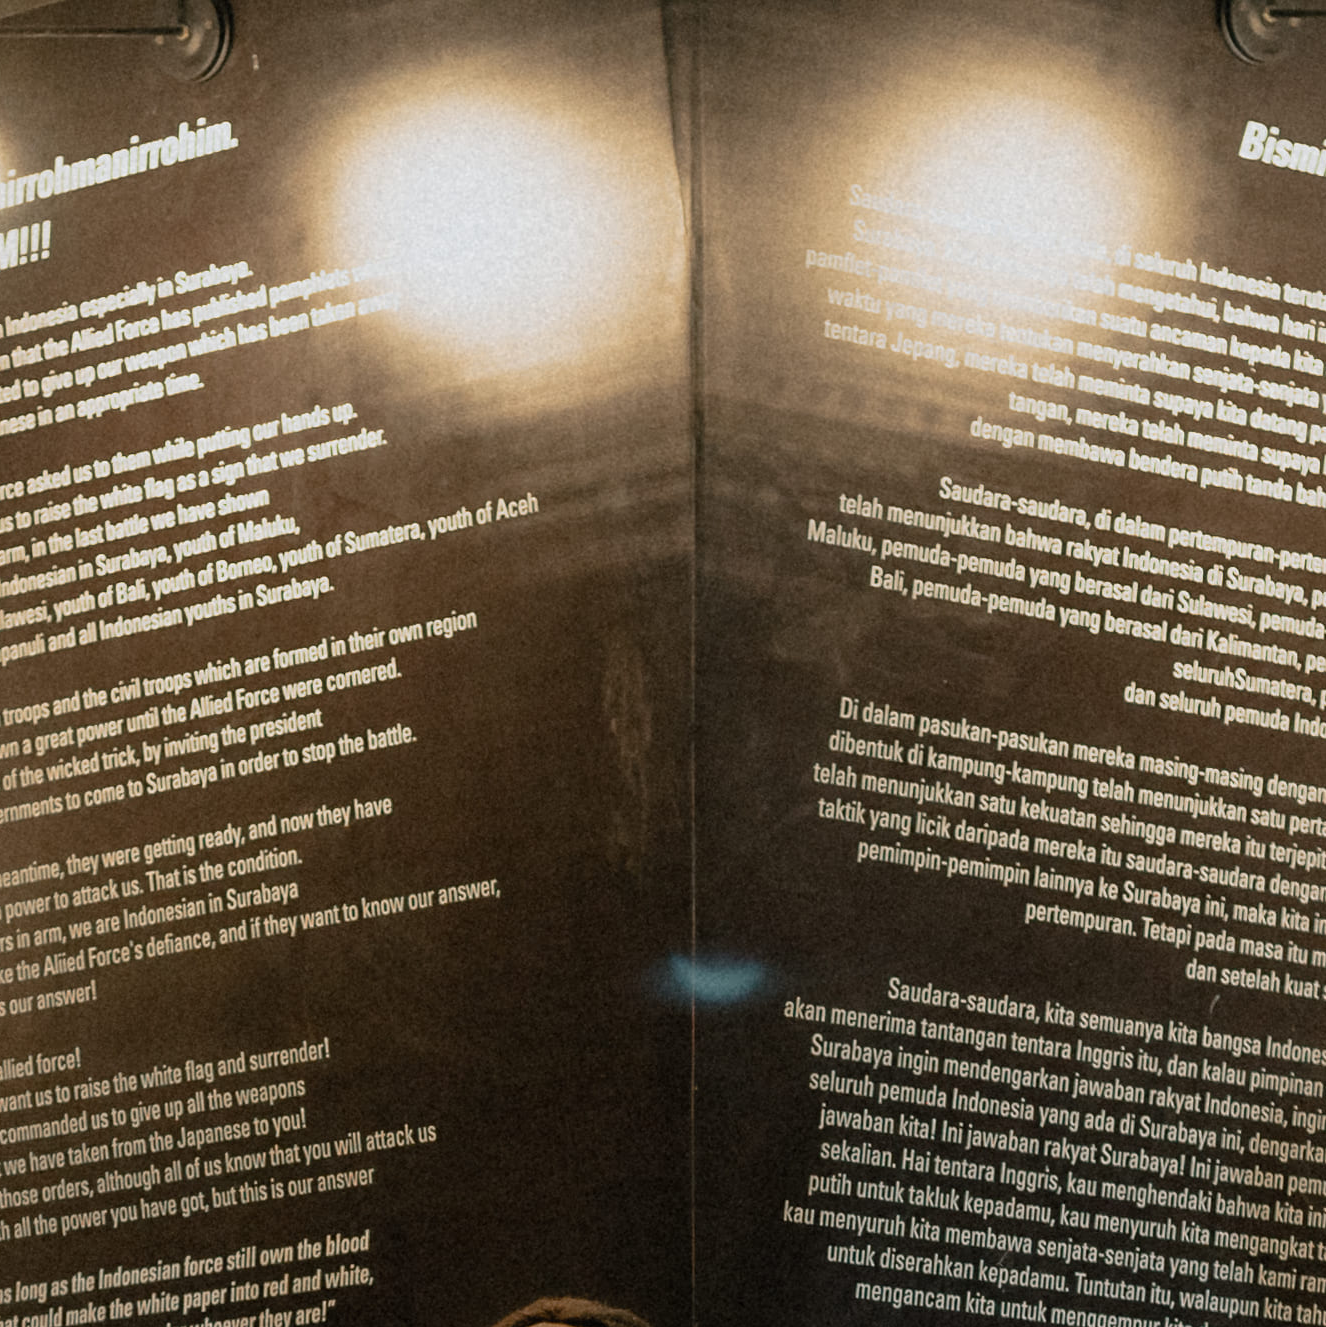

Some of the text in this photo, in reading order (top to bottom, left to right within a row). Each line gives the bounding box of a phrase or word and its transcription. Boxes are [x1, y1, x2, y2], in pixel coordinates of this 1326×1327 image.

[9, 995, 34, 1015] our
[36, 979, 97, 1011] answer!
[1185, 957, 1217, 983] dan
[1220, 968, 1281, 993] setelah
[1284, 972, 1321, 1000] kuat
[35, 1046, 81, 1075] force!
[15, 1280, 48, 1304] long
[50, 1279, 69, 1297] as
[71, 1271, 96, 1294] the
[98, 1259, 181, 1290] Indonesian
[183, 1255, 224, 1277] force
[226, 1245, 257, 1271] still
[259, 1245, 294, 1267] own
[296, 1238, 322, 1261] the
[325, 1228, 370, 1257] blood
